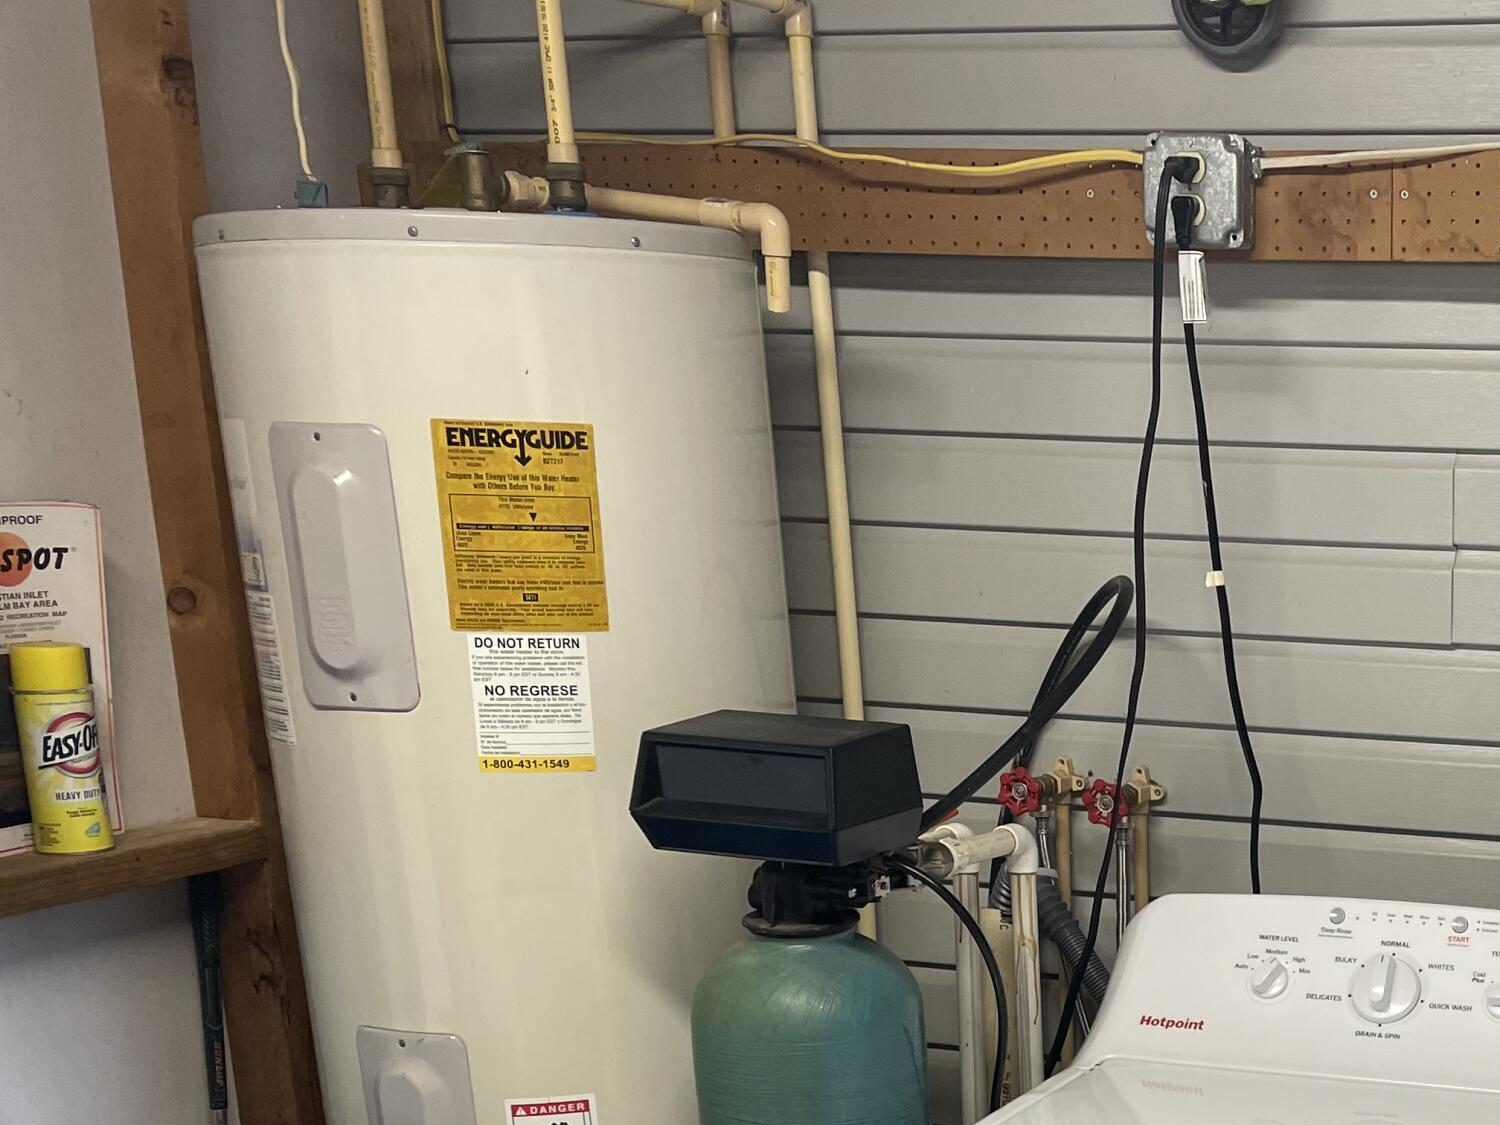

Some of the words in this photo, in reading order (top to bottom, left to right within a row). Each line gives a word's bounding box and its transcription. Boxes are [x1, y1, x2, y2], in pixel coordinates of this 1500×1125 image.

[445, 426, 589, 450] ENERGYGUIDE
[446, 472, 472, 481] Compare
[474, 472, 484, 480] the
[485, 472, 507, 482] Energy
[508, 473, 520, 481] Use
[521, 473, 528, 481] of
[529, 474, 540, 482] this
[541, 474, 559, 482] Water
[487, 482, 507, 490] Others
[509, 483, 528, 491] Before
[531, 483, 541, 491] You
[0, 515, 43, 525] PROOF
[23, 590, 49, 599] INLET
[13, 601, 31, 609] BAY
[33, 599, 58, 608] AREA
[474, 637, 493, 649] DO
[497, 637, 524, 649] NOT
[528, 637, 580, 649] RETURN
[484, 685, 505, 696] NO
[510, 685, 579, 696] REGRESE
[482, 759, 570, 769] 1-800-431-1549
[55, 791, 81, 801] HEAVY
[84, 789, 101, 798] DUTY
[1259, 934, 1279, 942] WATER
[1280, 935, 1300, 943] LEVEL
[1448, 935, 1470, 944] START
[1381, 939, 1411, 949] NORMAL
[1265, 948, 1288, 956] Medium
[1292, 956, 1306, 964] High
[1334, 956, 1357, 964] BULKY
[1234, 962, 1249, 970] Auto
[1427, 963, 1455, 972] WHITES
[1306, 992, 1342, 1002] DELICATES
[1429, 1002, 1451, 1011] QUICK
[1451, 1004, 1473, 1012] WASH
[1139, 1015, 1205, 1031] Hotpoint
[1355, 1030, 1377, 1039] DRAIN
[529, 1102, 585, 1115] DANGER
